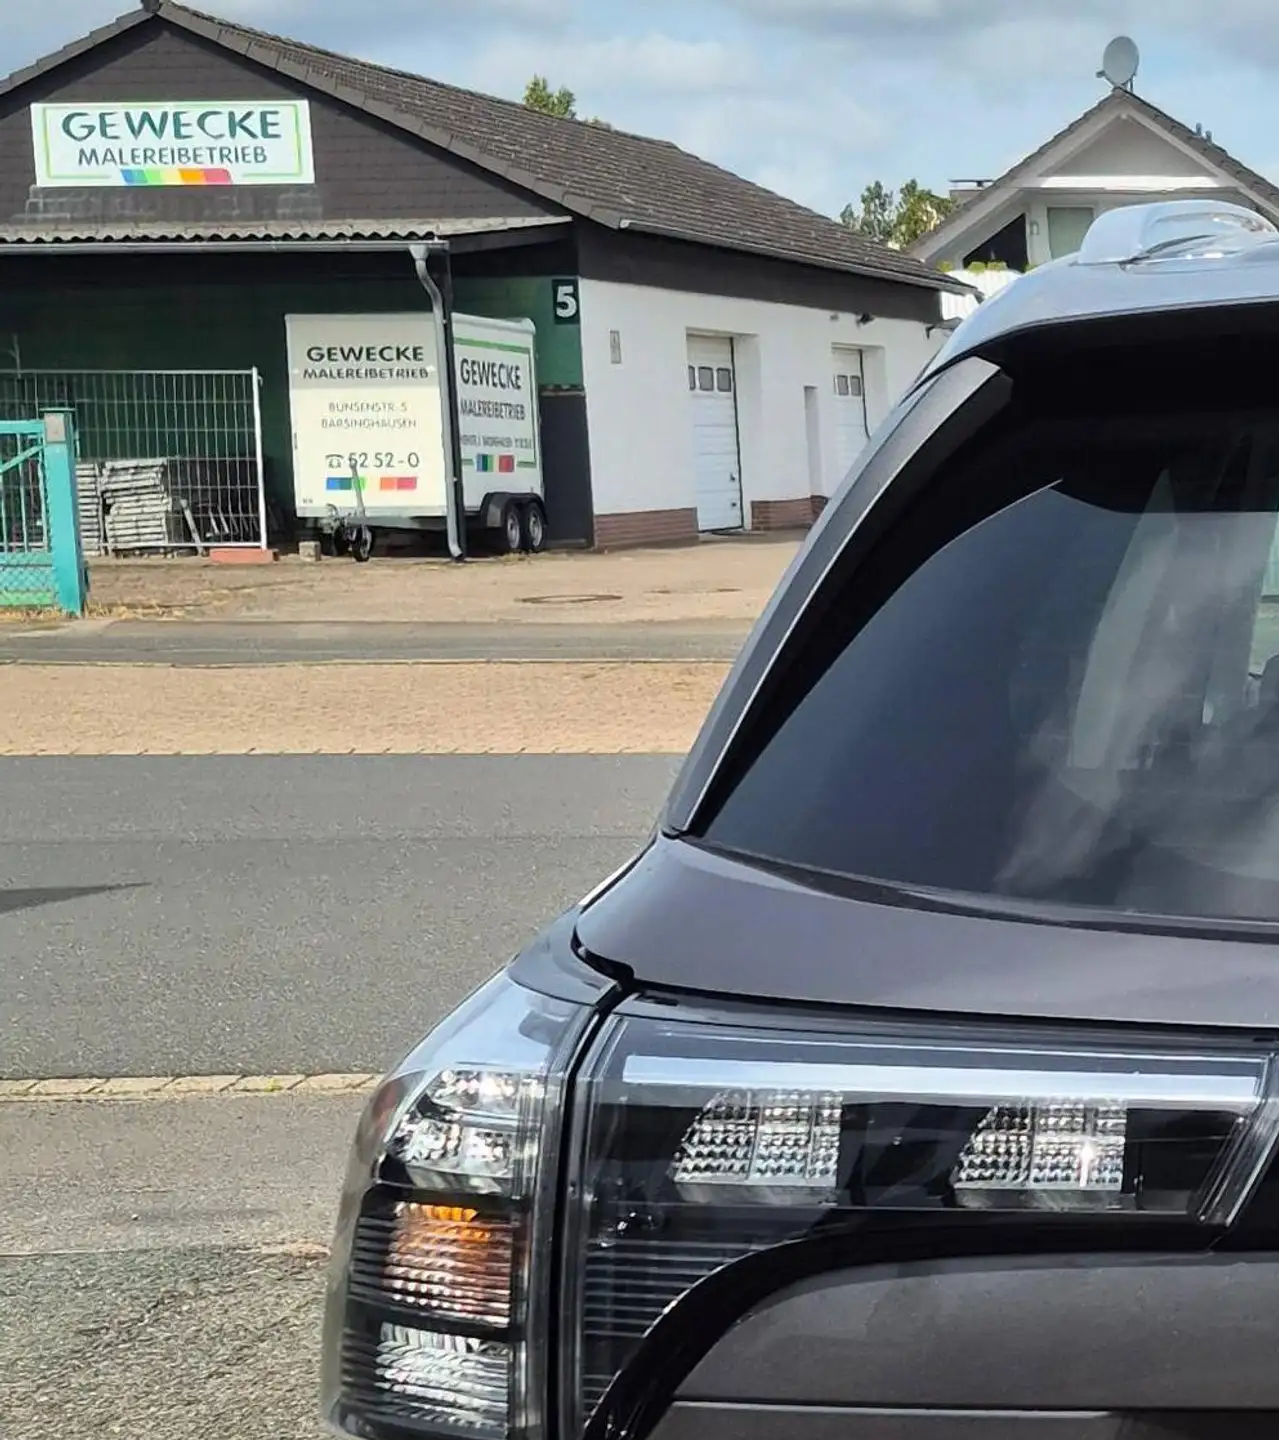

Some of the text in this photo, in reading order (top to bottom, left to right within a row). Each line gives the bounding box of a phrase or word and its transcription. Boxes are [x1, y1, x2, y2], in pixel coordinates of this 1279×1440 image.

[62, 110, 282, 142] GEWECKE
[77, 146, 268, 166] MALEREIBETRIEB
[556, 286, 577, 318] 5
[306, 345, 424, 362] GEWECKE
[303, 367, 429, 379] MALEREIBETRIEB
[460, 357, 522, 390] GEWECKE
